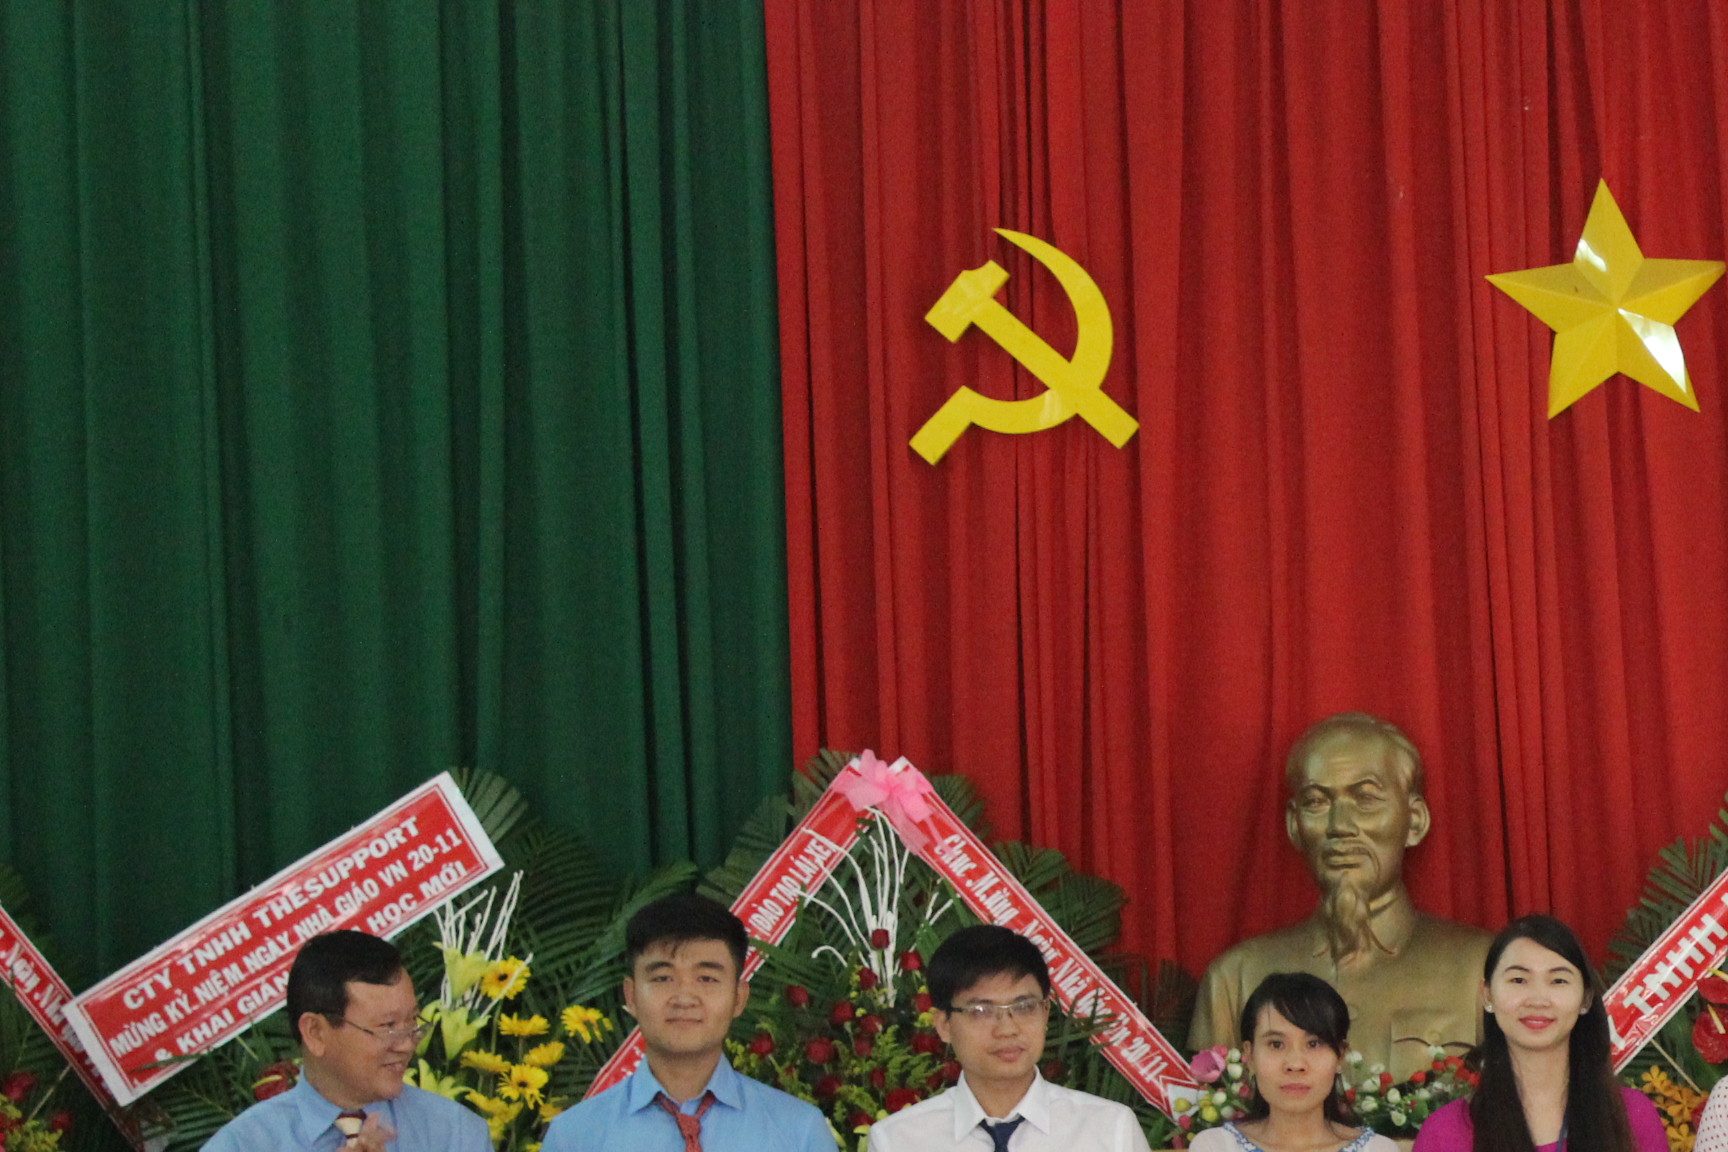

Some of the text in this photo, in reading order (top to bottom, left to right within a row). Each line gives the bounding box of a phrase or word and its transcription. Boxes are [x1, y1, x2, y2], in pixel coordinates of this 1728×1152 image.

[108, 1012, 168, 1060] MỪNG
[163, 986, 194, 1025] KỶ
[192, 955, 243, 1012] NIỆM
[242, 925, 294, 976] NGÀY
[293, 902, 336, 943] NHÀ
[334, 876, 381, 915] GIÁO
[378, 858, 409, 888] VN
[407, 827, 464, 873] 20-11
[122, 815, 420, 1011] CTY TNHH THESUPPORT
[366, 859, 469, 935] HỌC MỚI
[175, 1009, 235, 1055] KHAI
[237, 965, 291, 1016] GIẢN
[1622, 912, 1728, 1017] TNHH
